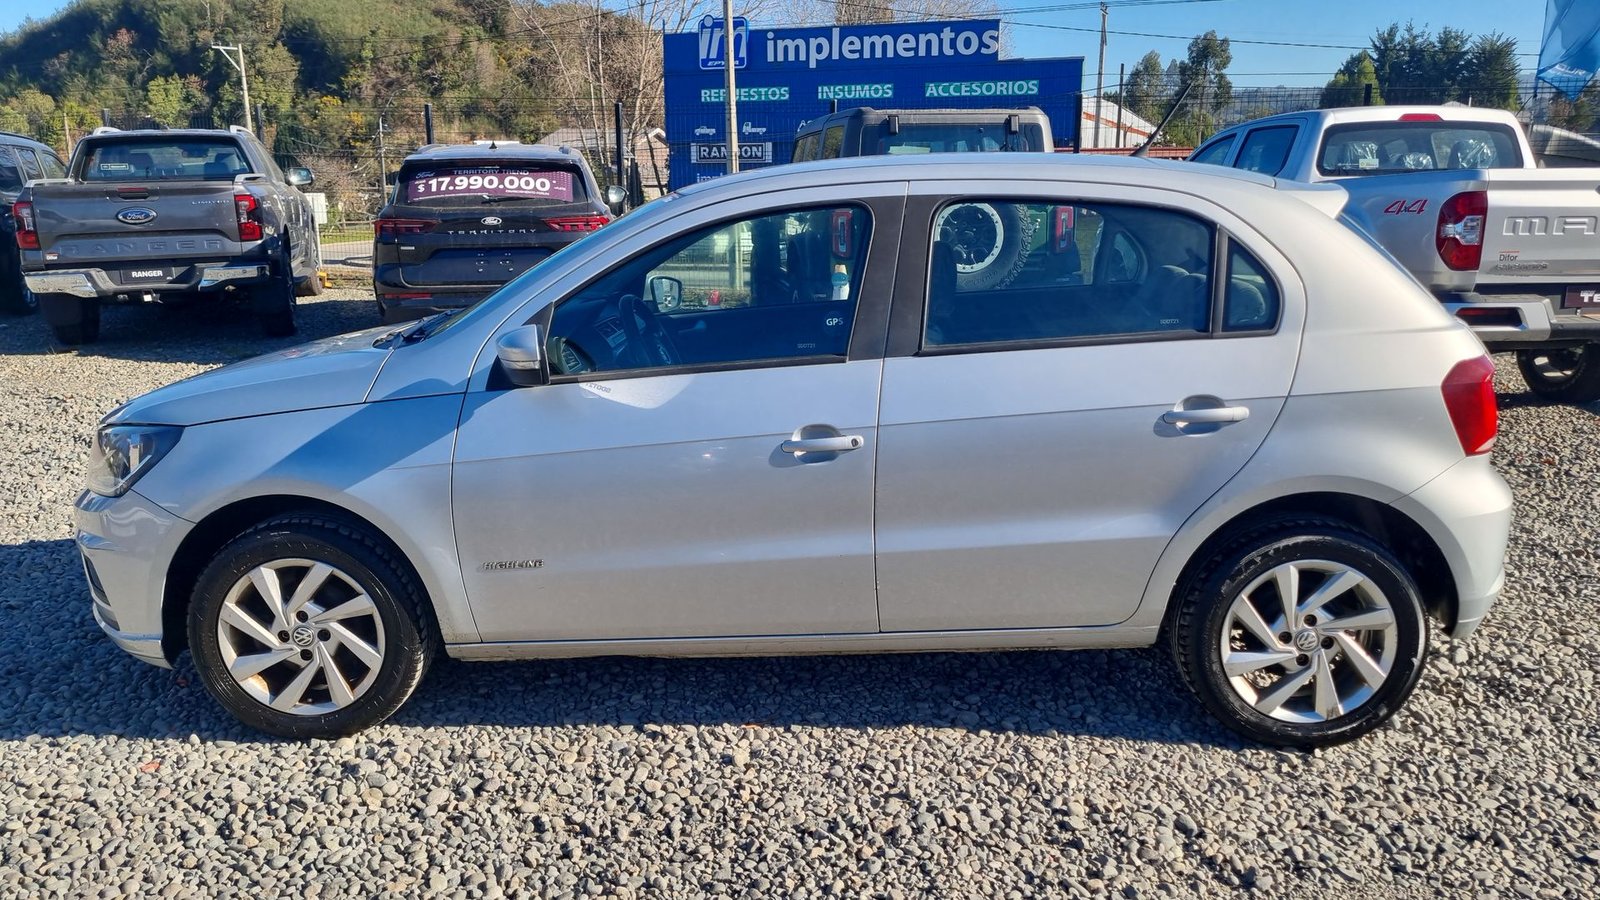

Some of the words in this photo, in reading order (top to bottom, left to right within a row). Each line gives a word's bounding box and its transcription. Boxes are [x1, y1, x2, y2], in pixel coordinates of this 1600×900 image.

[766, 26, 999, 69] implementos
[817, 83, 893, 99] INSUMOS
[925, 80, 1039, 97] ACCESORIOS
[700, 146, 762, 158] RANON
[1383, 198, 1428, 216] 4x4
[1499, 254, 1518, 262] Difor
[131, 270, 164, 278] RANGER
[826, 317, 844, 326] GPS
[482, 559, 545, 570] HIGHLINE
